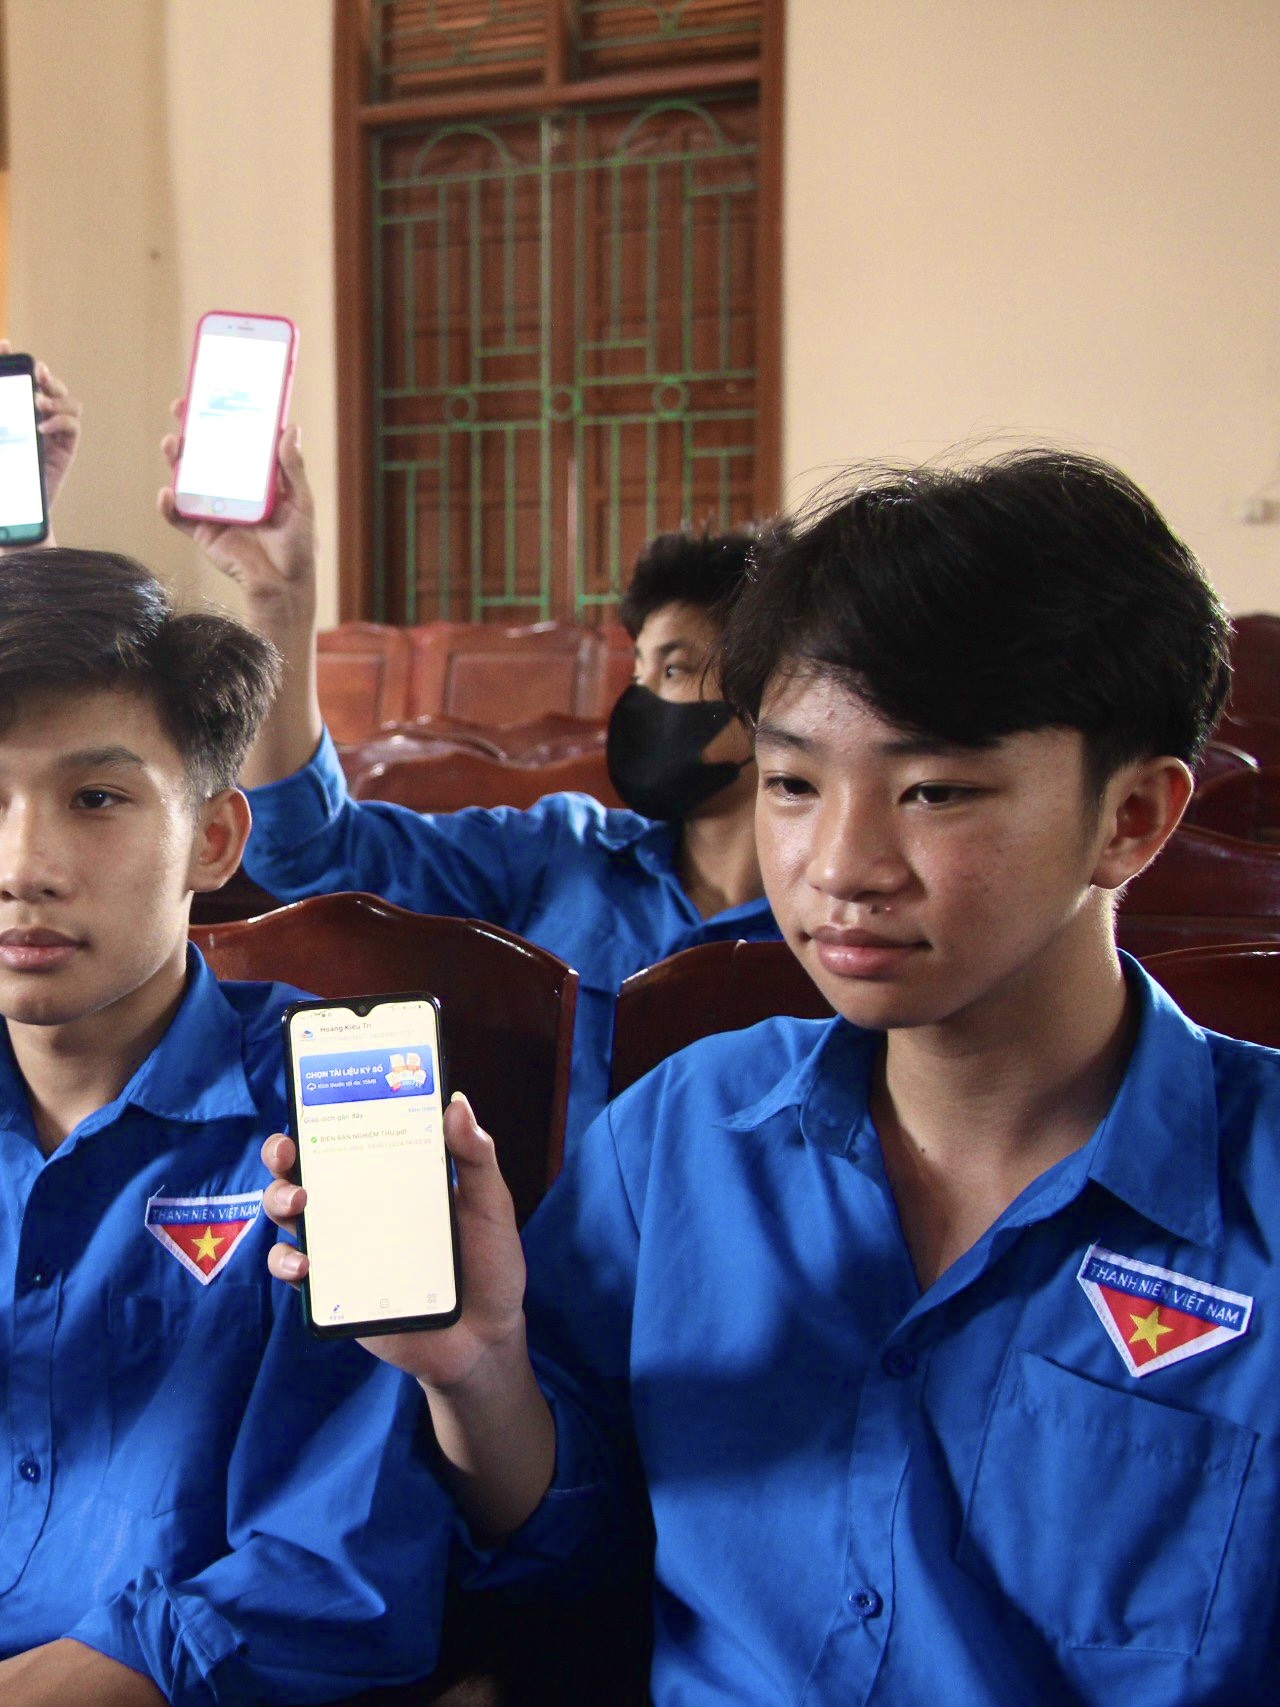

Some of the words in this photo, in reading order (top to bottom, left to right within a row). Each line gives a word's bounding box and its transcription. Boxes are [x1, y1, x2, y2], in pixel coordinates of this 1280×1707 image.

[305, 1071, 328, 1080] CHỌN
[152, 1208, 189, 1221] THANH
[218, 1203, 238, 1220] VIỆT
[240, 1203, 260, 1217] NAM
[1090, 1263, 1137, 1290] THANH
[1173, 1289, 1206, 1311] VIỆT
[1205, 1302, 1240, 1324] NAM
